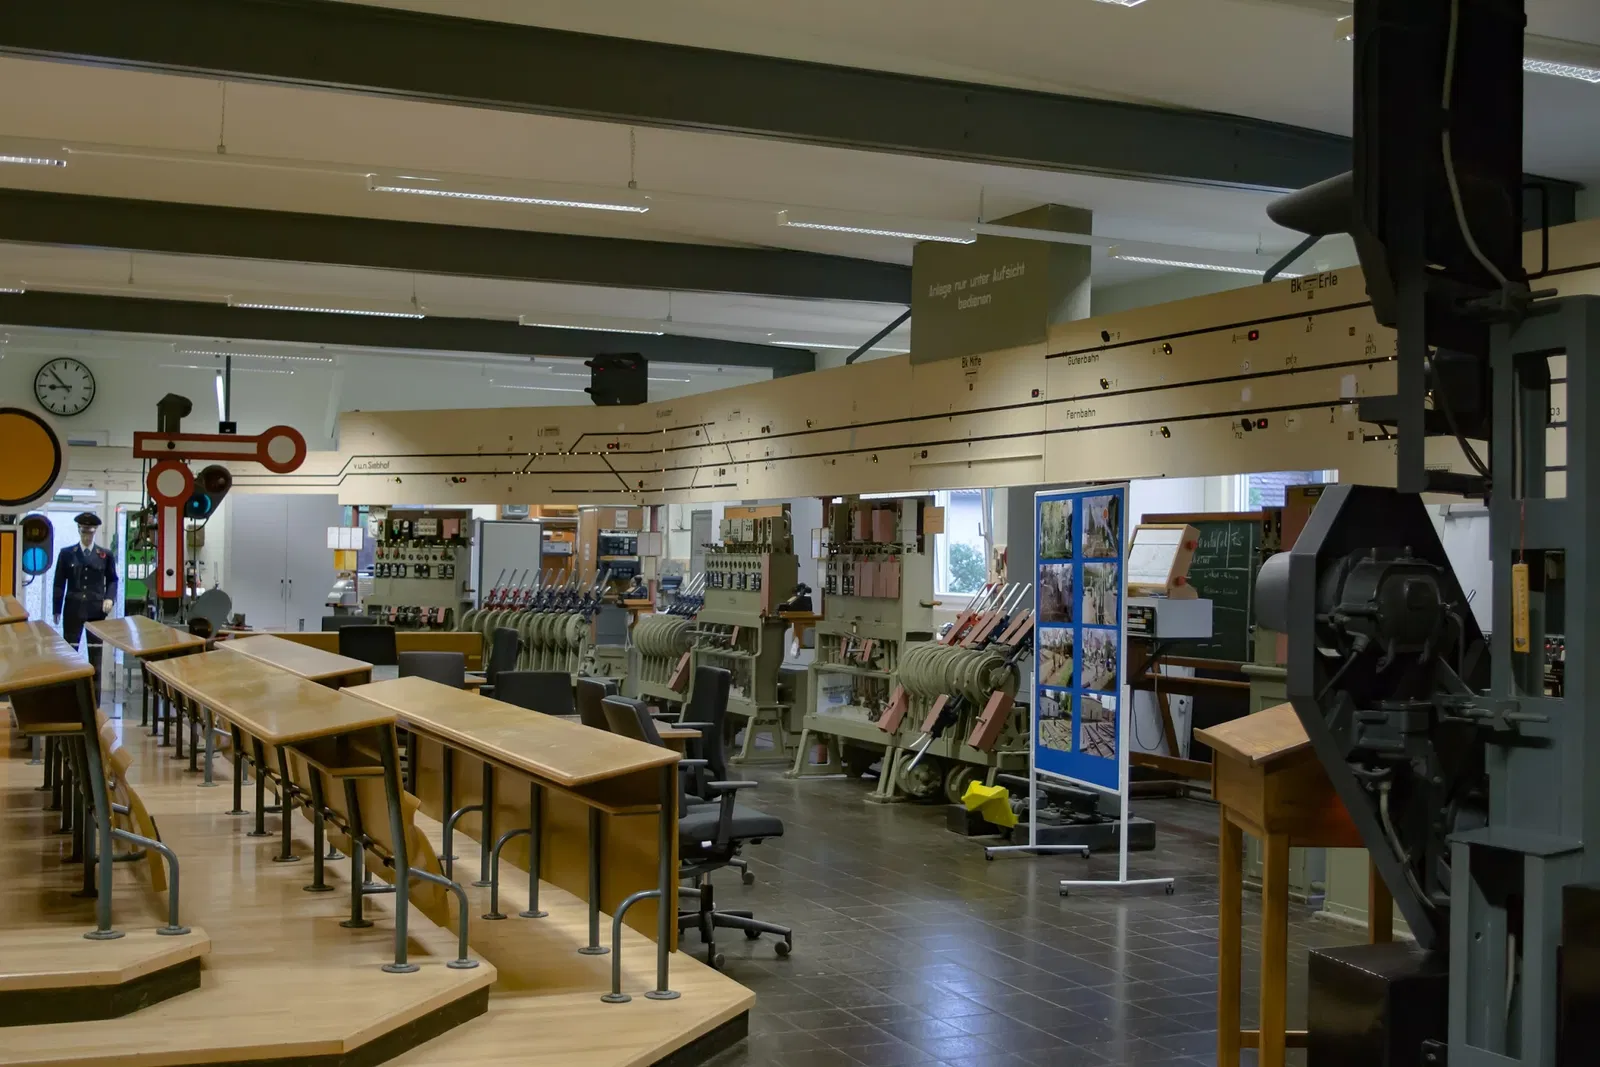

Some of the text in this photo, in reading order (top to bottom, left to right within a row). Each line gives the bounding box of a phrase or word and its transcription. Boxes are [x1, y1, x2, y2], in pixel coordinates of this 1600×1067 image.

[954, 279, 967, 290] nur
[970, 273, 990, 287] unter
[992, 262, 1025, 282] Aufsicht
[1290, 272, 1337, 293] Bk Erle
[957, 293, 992, 310] bedienen
[1067, 353, 1100, 366] Güterbahn
[1066, 408, 1096, 419] Fernbahn
